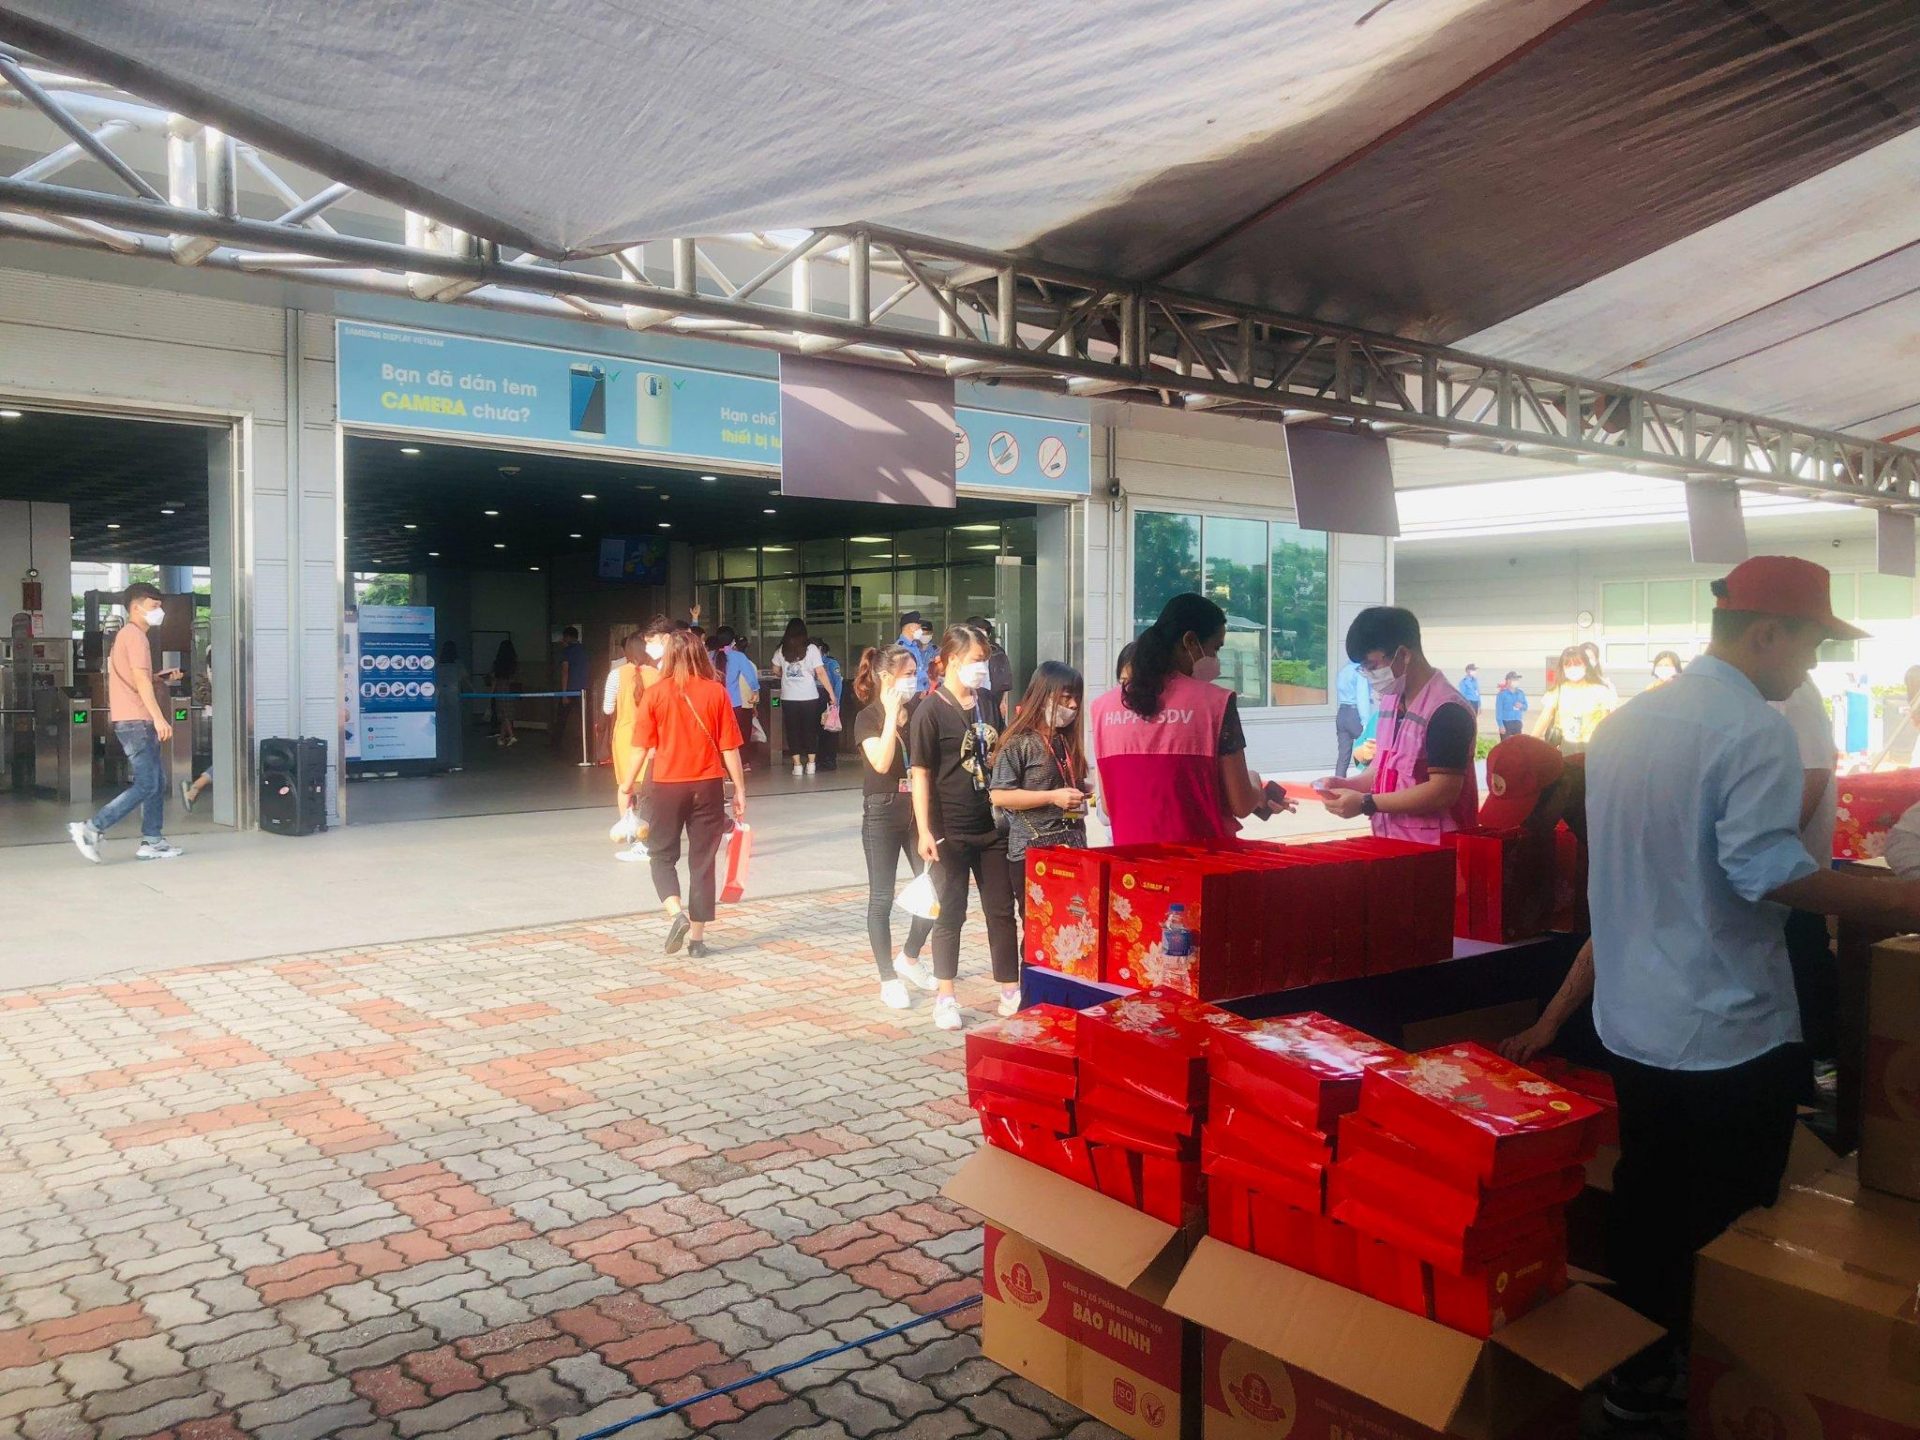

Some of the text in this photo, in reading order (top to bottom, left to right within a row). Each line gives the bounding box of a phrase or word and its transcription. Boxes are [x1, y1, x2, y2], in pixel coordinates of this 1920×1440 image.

[381, 363, 537, 397] Bạn đã dán tem
[381, 391, 531, 423] CAMERA chưa?
[720, 406, 777, 426] Hạn chế
[1108, 1319, 1151, 1355] MINH
[1116, 1384, 1133, 1401] ISO
